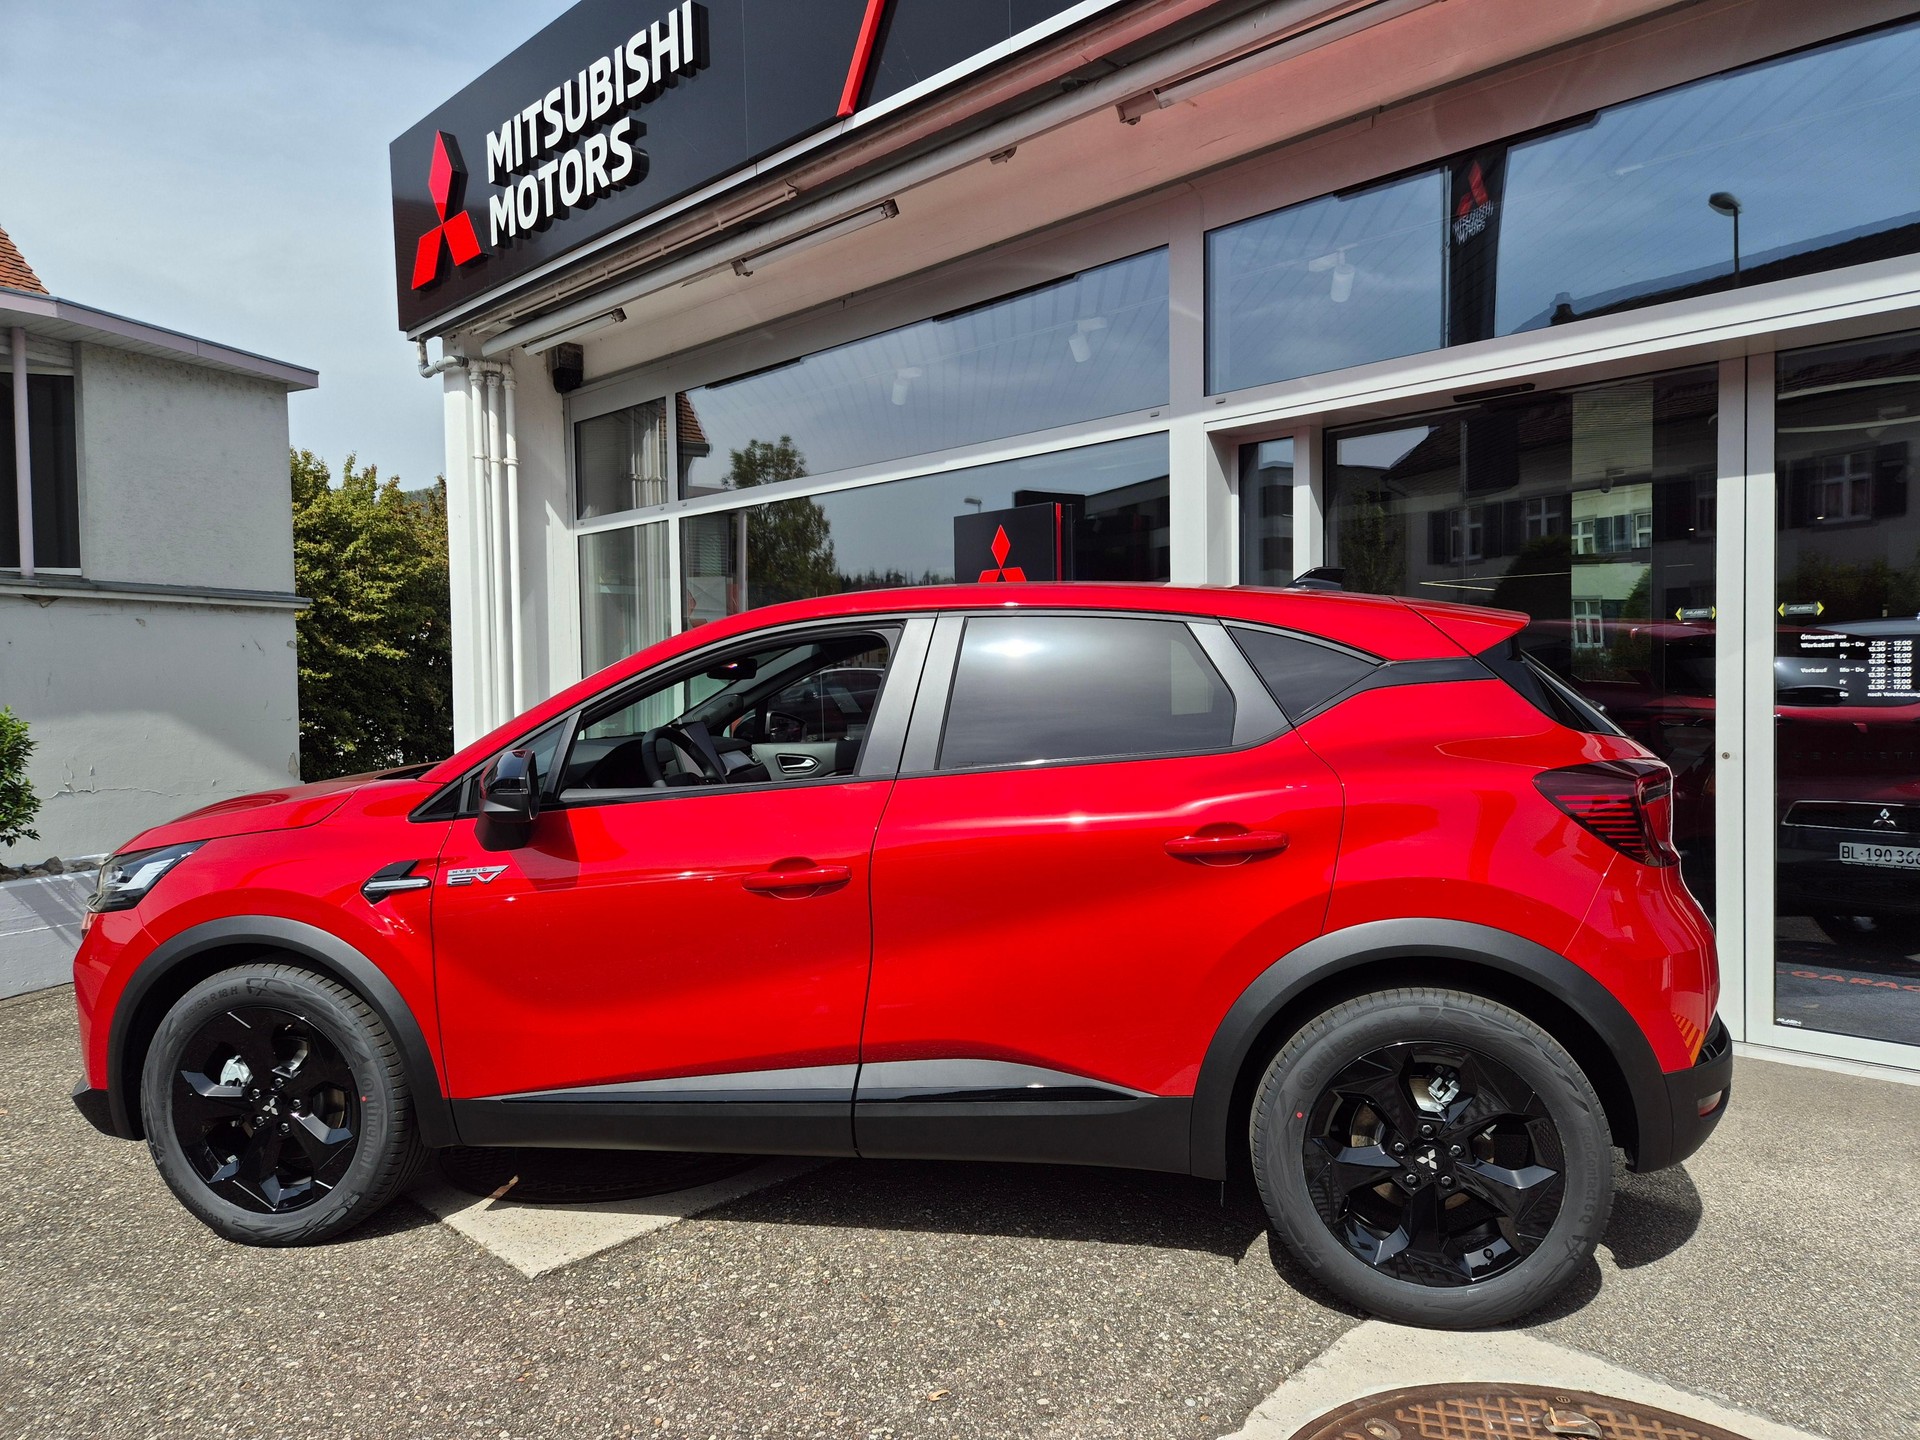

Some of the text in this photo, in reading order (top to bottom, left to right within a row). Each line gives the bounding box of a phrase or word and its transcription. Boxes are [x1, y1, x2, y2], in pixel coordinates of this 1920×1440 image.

[487, 0, 694, 184] MITSUBISHI
[489, 117, 634, 247] MOTORS
[447, 865, 509, 886] EV
[1842, 846, 1859, 860] BL
[1865, 847, 1893, 863] 190
[1581, 1127, 1598, 1202] EcoContact
